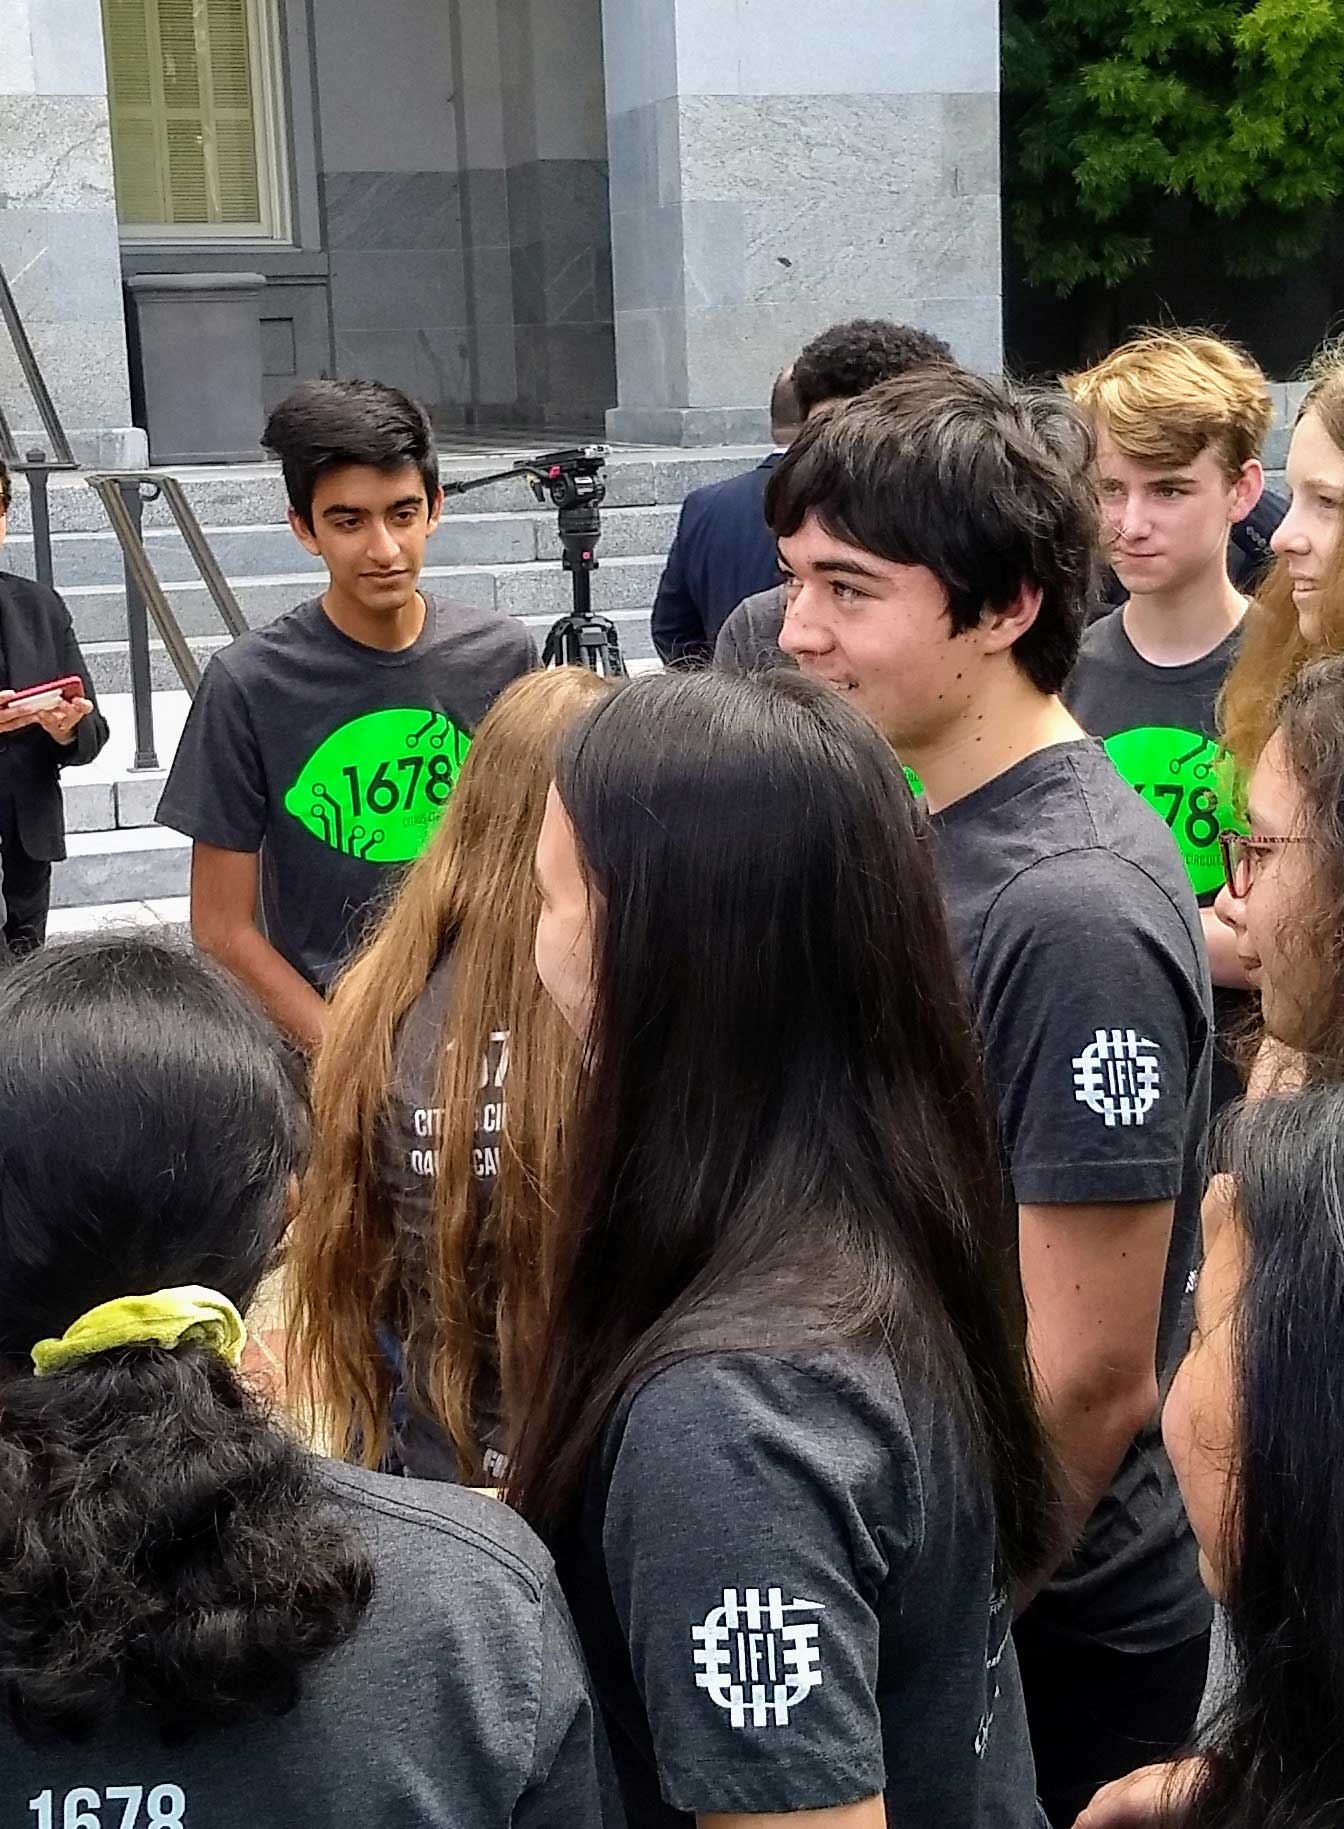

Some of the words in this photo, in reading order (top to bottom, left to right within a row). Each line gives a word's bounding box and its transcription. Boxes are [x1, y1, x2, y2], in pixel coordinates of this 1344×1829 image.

[342, 754, 453, 817] 1678
[1106, 1060, 1136, 1095] IFI
[736, 1632, 777, 1682] IFI
[29, 1783, 186, 1829] 1678
